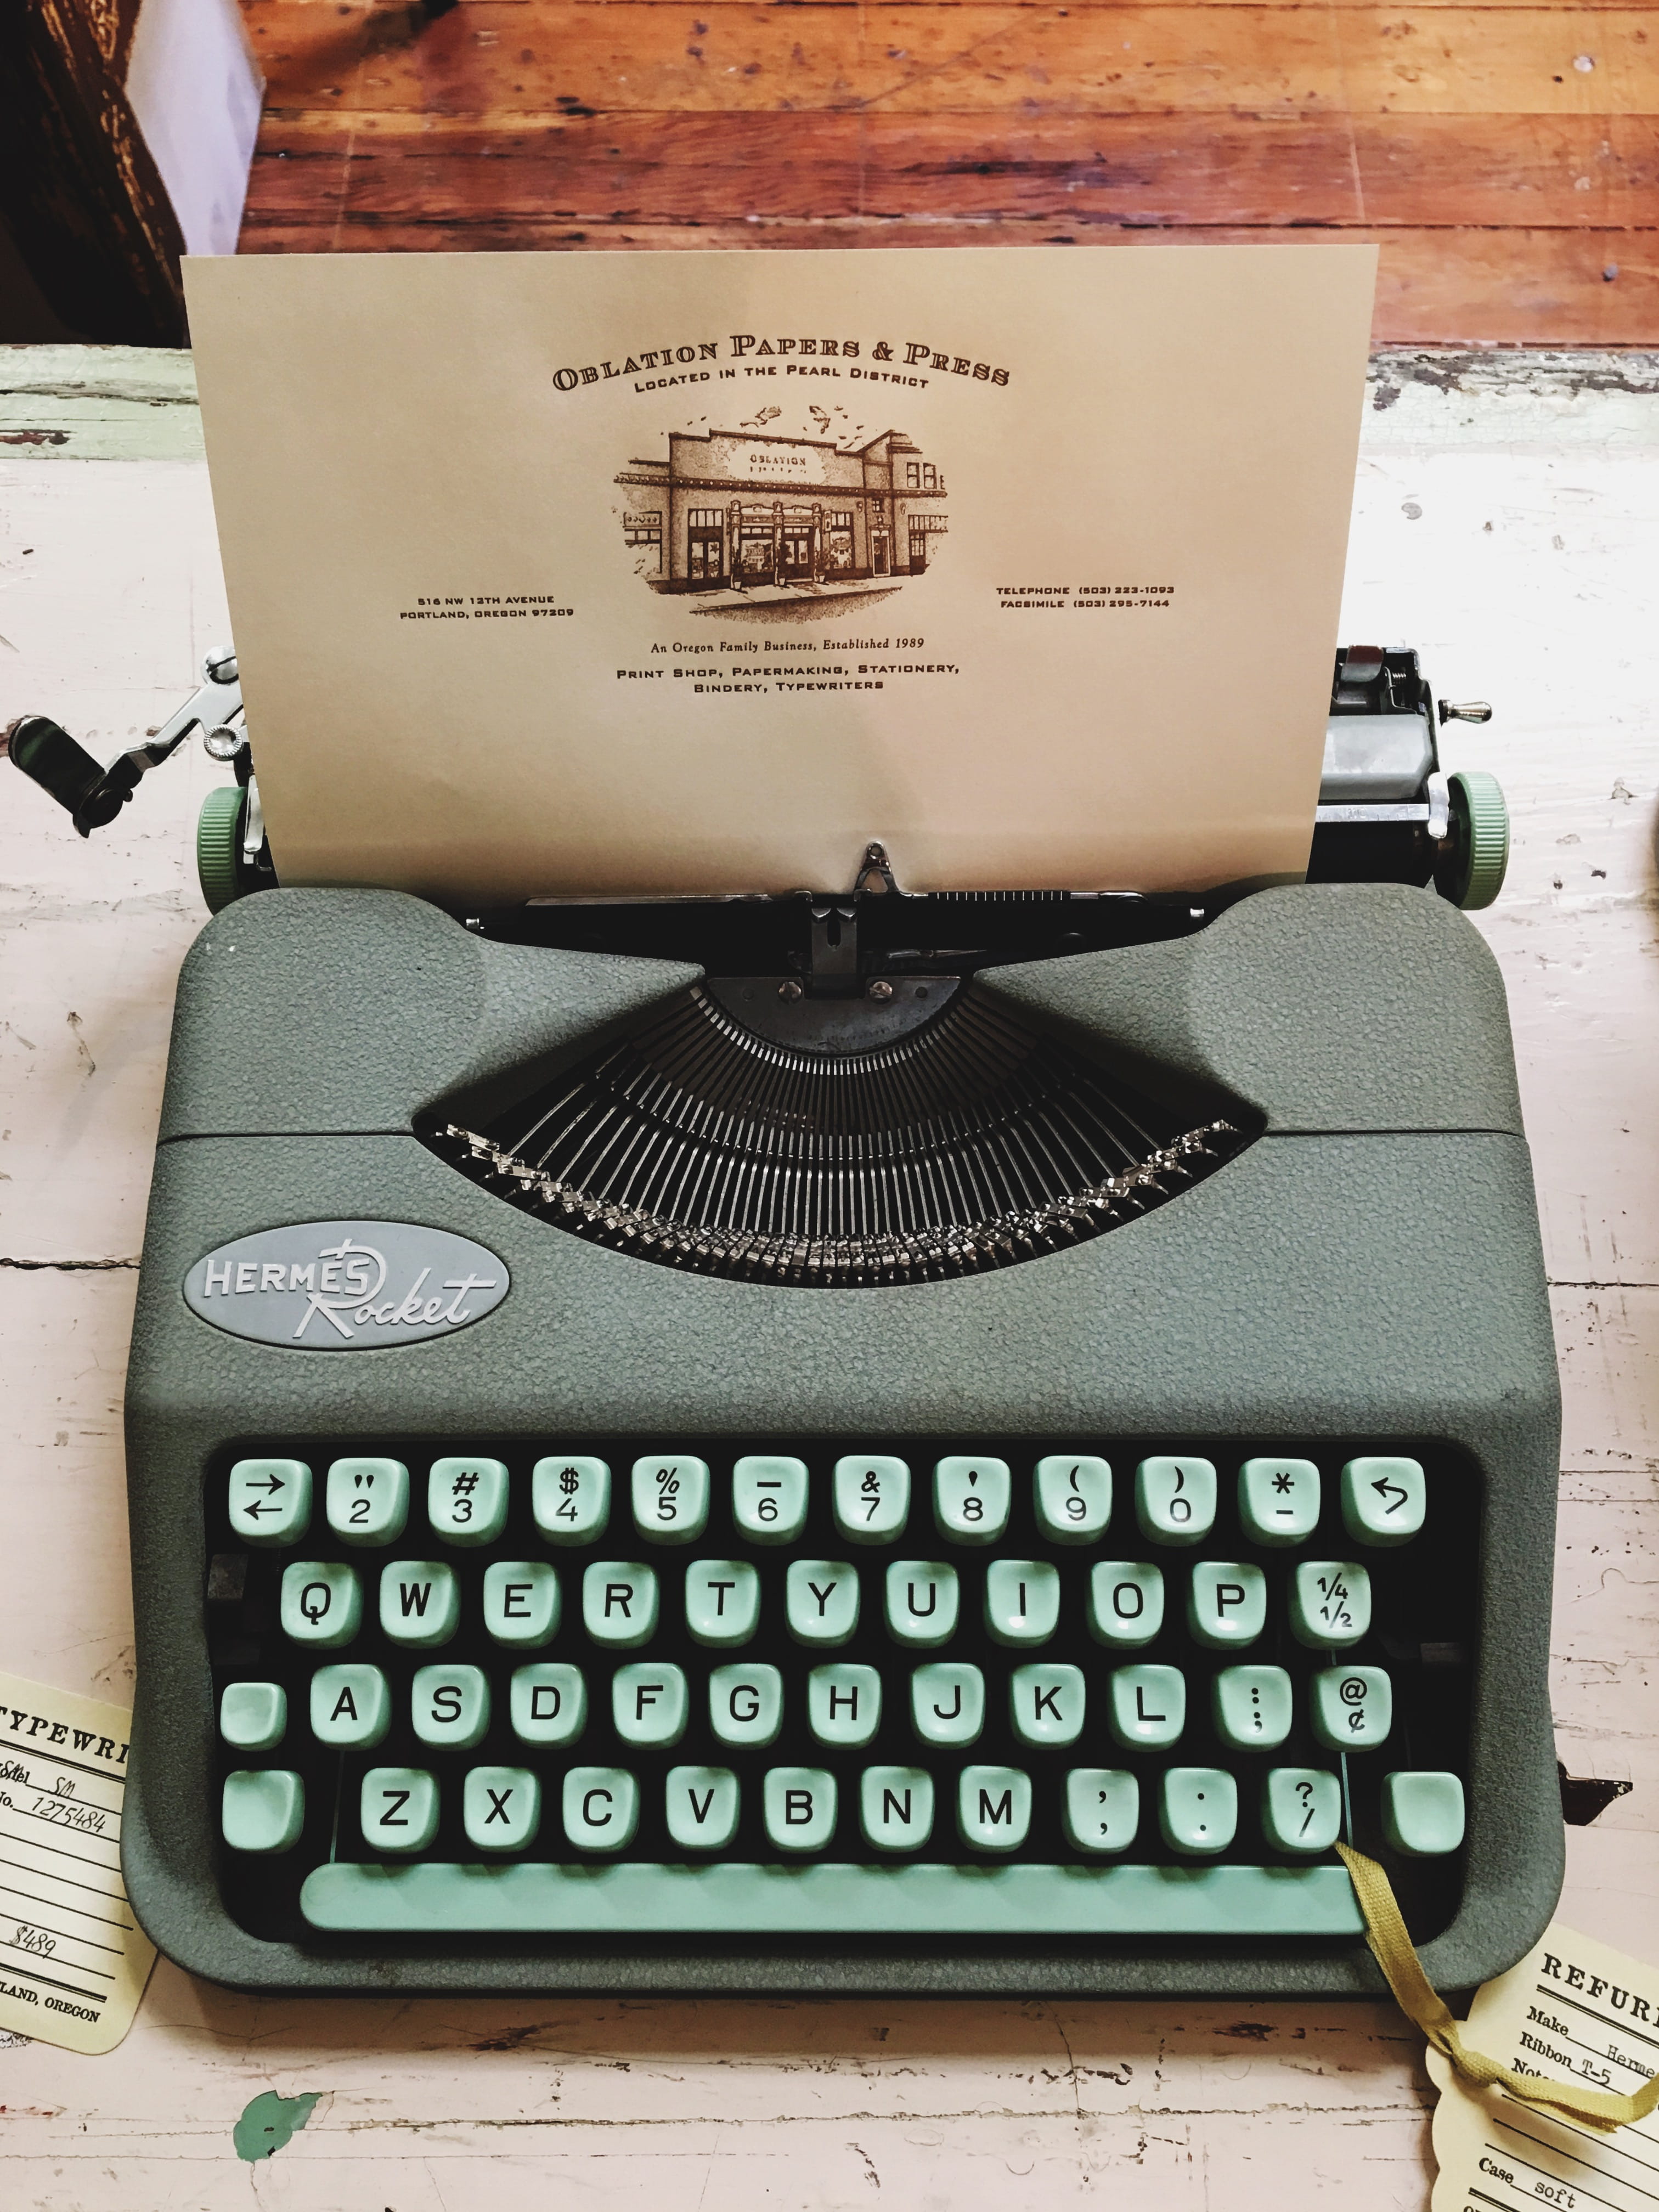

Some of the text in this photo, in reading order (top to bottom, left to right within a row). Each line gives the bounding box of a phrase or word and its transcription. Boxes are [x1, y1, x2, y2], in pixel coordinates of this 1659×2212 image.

[552, 334, 1011, 392] OBLATION PAPERS & PRESS
[634, 364, 930, 393] LOCATED IN THE PEARL DISTRICT
[750, 454, 806, 466] OBLATION
[417, 597, 441, 606] 516
[505, 595, 555, 604] AVENUE
[996, 586, 1175, 595] TELEPHONE (503) 223-1093
[1001, 600, 1065, 608] FACSIMILE
[1073, 600, 1105, 608] (503)
[399, 608, 574, 619] PORTLAND, OREGON 97209
[650, 637, 924, 654] An Oregon Family Business, Established 1989
[617, 664, 960, 679] PRINT SHOP, PAPERMAKING, STATIONERY,
[694, 681, 884, 694] BINDERY, TYPEWRITERS
[292, 1239, 497, 1339] Rocket
[452, 1472, 479, 1496] #
[559, 1467, 579, 1495] $
[656, 1467, 680, 1494] %
[861, 1471, 881, 1493] &
[349, 1499, 371, 1523] 2
[452, 1499, 472, 1523] 3
[556, 1498, 578, 1522] 4
[657, 1496, 677, 1521] 5
[758, 1498, 778, 1521] 6
[861, 1497, 881, 1521] 7
[963, 1497, 984, 1521] 8
[1066, 1497, 1087, 1521] 9
[301, 1582, 331, 1625] Q
[399, 1582, 432, 1617] W
[504, 1583, 533, 1618] E
[605, 1583, 633, 1618] R
[708, 1582, 736, 1616] T
[808, 1582, 837, 1616] Y
[907, 1582, 936, 1617] U
[1019, 1582, 1026, 1616] I
[1113, 1582, 1143, 1619] O
[1216, 1583, 1245, 1617] P
[330, 1686, 358, 1721] A
[431, 1686, 462, 1723] S
[531, 1686, 561, 1720] D
[636, 1685, 664, 1720] F
[730, 1685, 759, 1722] G
[830, 1685, 858, 1720] H
[933, 1685, 961, 1719] J
[1035, 1686, 1063, 1721] K
[1136, 1686, 1166, 1722] L
[1339, 1677, 1368, 1706] @
[0, 1706, 129, 1764] YPEWRI
[32, 1797, 106, 1832] 1275484
[380, 1790, 410, 1826] Z
[484, 1789, 514, 1824] X
[583, 1788, 613, 1826] C
[688, 1788, 715, 1824] V
[786, 1790, 813, 1825] B
[883, 1788, 911, 1824] N
[979, 1788, 1012, 1825] M
[1295, 1781, 1313, 1808] ?
[9, 1925, 57, 1959] $489
[44, 1997, 100, 2023] OREGON
[1526, 2005, 1656, 2079] Make Herme
[1519, 2031, 1612, 2085] Ribbon T-5
[1479, 2157, 1576, 2209] Case soft
